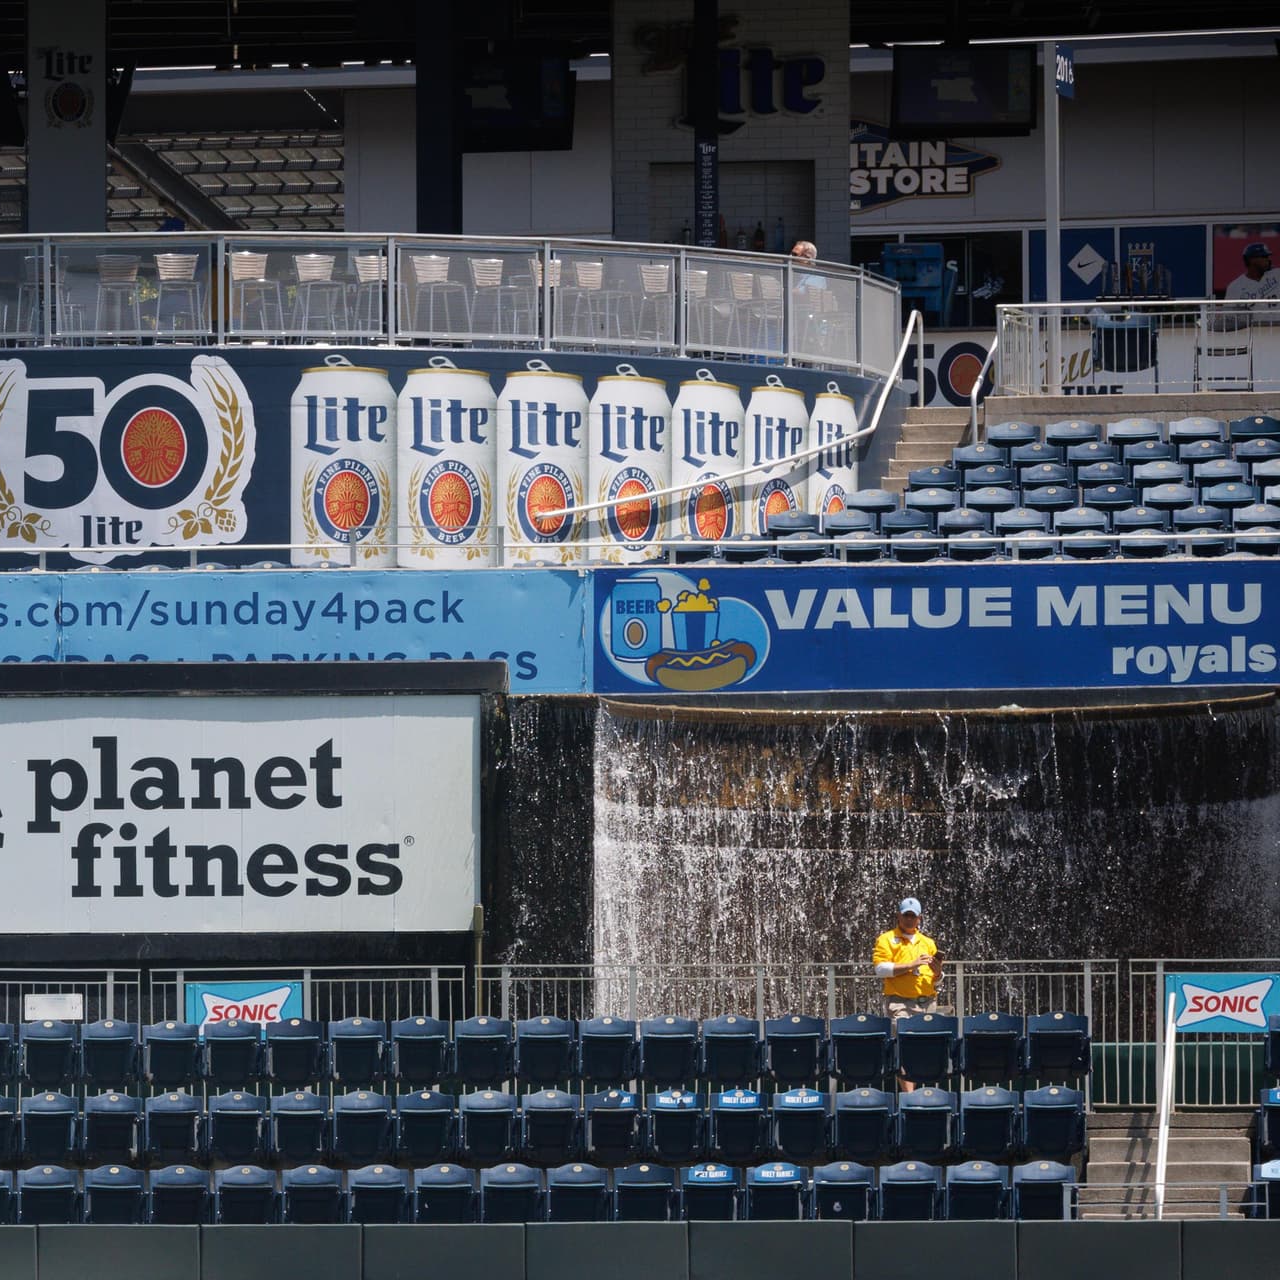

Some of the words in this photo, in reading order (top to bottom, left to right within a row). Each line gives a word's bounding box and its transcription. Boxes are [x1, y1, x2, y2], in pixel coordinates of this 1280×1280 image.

[849, 167, 969, 195] STORE
[23, 384, 209, 510] 50
[304, 395, 387, 456] Lite
[410, 396, 488, 456] Lite
[509, 399, 581, 459] Lite
[600, 403, 665, 463] Lite
[682, 408, 739, 468] Lite
[752, 414, 803, 474] Lite
[319, 461, 341, 485] FINE
[344, 459, 378, 497] PILSNER
[426, 462, 446, 485] FINE
[448, 461, 479, 498] PILSNER
[522, 466, 541, 489] FINE
[543, 464, 574, 501] PILSNER
[333, 530, 363, 542] BER
[438, 531, 466, 543] BEER
[616, 599, 655, 615] BEER
[765, 587, 1030, 631] VALUE
[1036, 583, 1263, 627] MENU
[1112, 636, 1277, 682] royals
[27, 736, 342, 833] planet
[71, 822, 404, 898] fitness
[209, 1004, 278, 1022] SONIC
[1188, 995, 1259, 1013] SONIC
